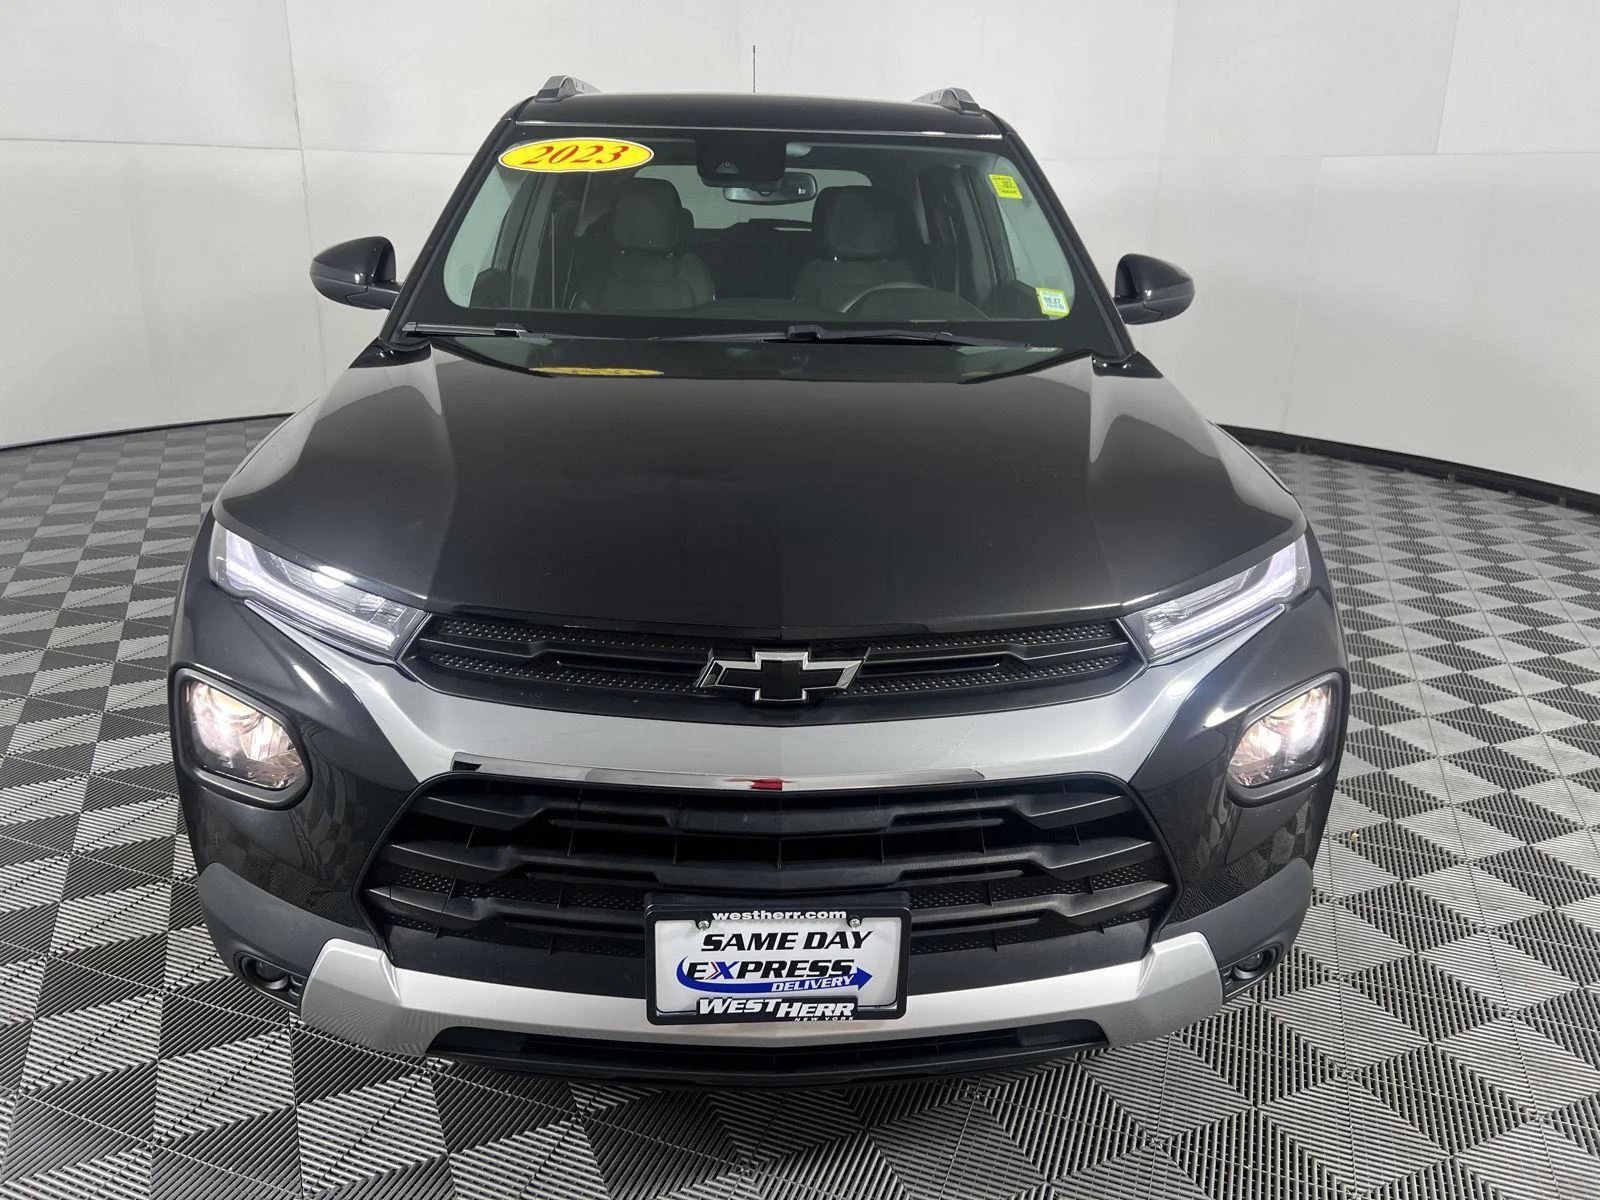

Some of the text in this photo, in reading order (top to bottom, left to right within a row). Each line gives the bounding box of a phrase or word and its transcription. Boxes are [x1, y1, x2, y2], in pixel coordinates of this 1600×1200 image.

[521, 145, 629, 164] 2023
[712, 910, 847, 920] westherr.com
[701, 931, 873, 951] SAME DAY
[687, 959, 854, 980] EXPRESS
[771, 976, 854, 992] DELIVERY
